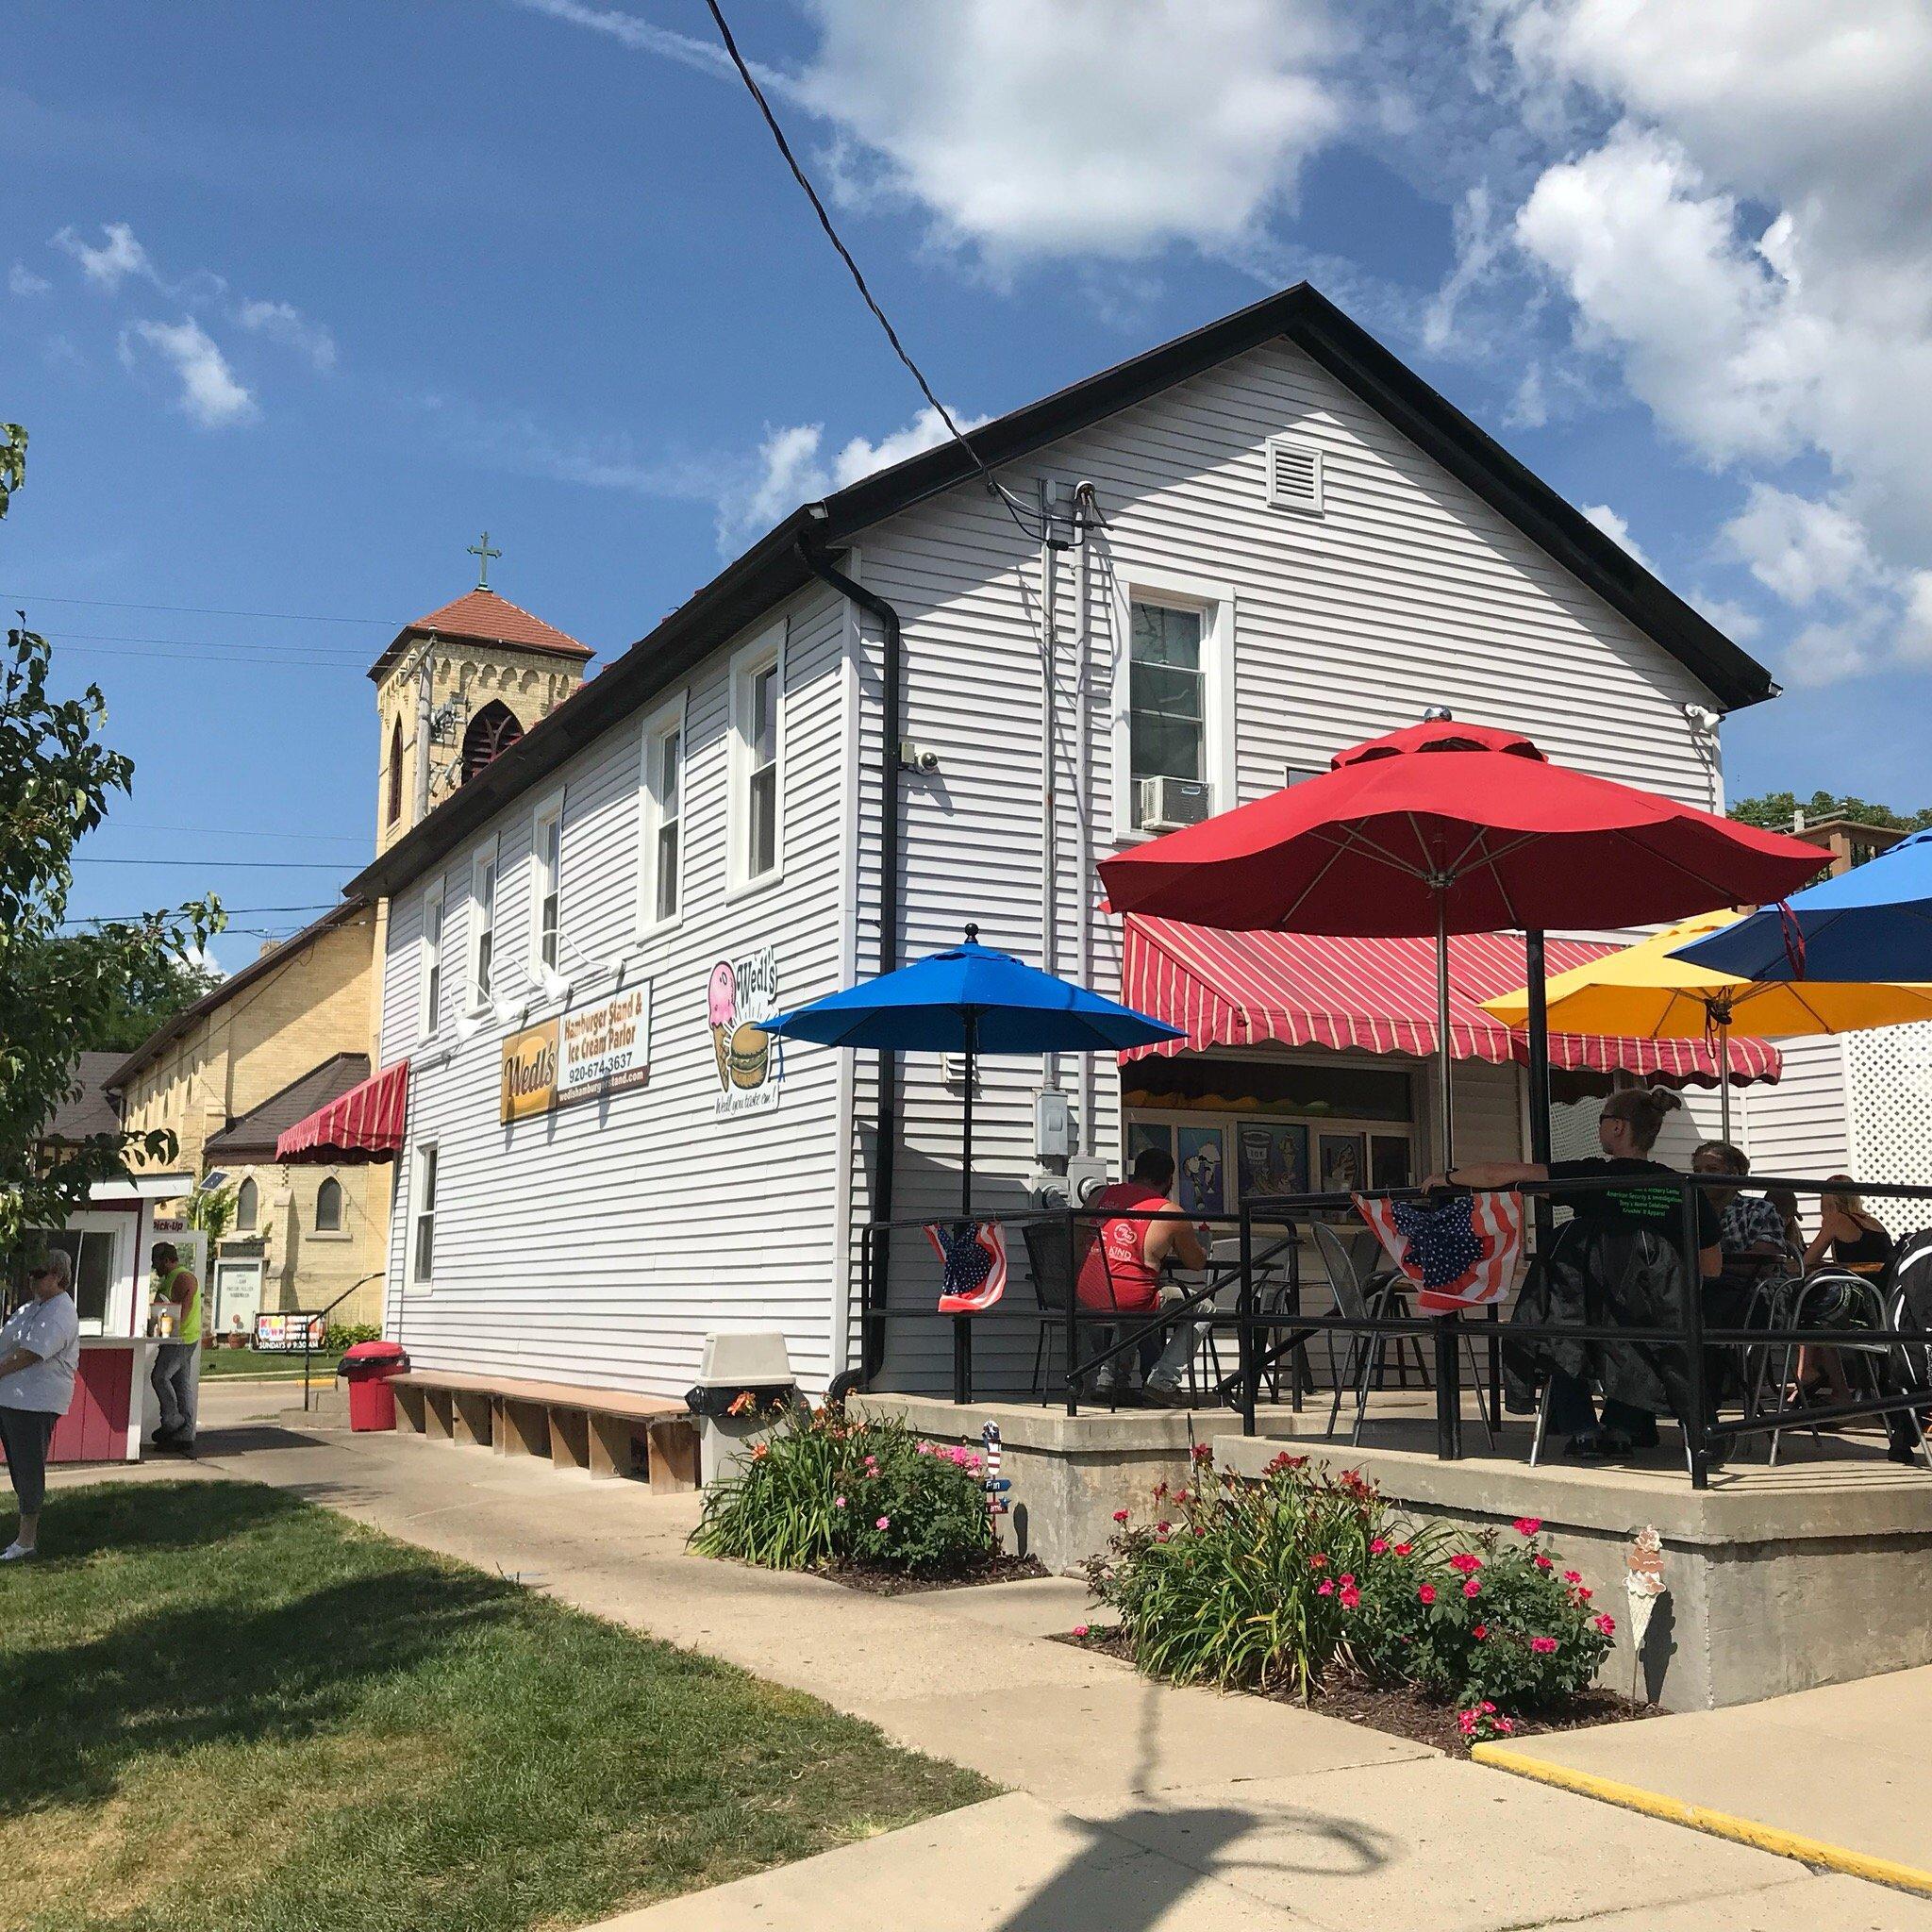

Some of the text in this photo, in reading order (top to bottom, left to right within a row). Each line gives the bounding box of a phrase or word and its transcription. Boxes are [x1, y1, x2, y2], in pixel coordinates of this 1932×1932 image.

[736, 949, 774, 1008] Wedl's
[564, 991, 642, 1041] Hamburger Stand &
[568, 1024, 636, 1064] Ice Cream Parlor
[504, 1040, 554, 1098] Wedl's
[569, 1052, 633, 1084] 920-674-3637
[258, 1341, 286, 1349] SUNDAYS
